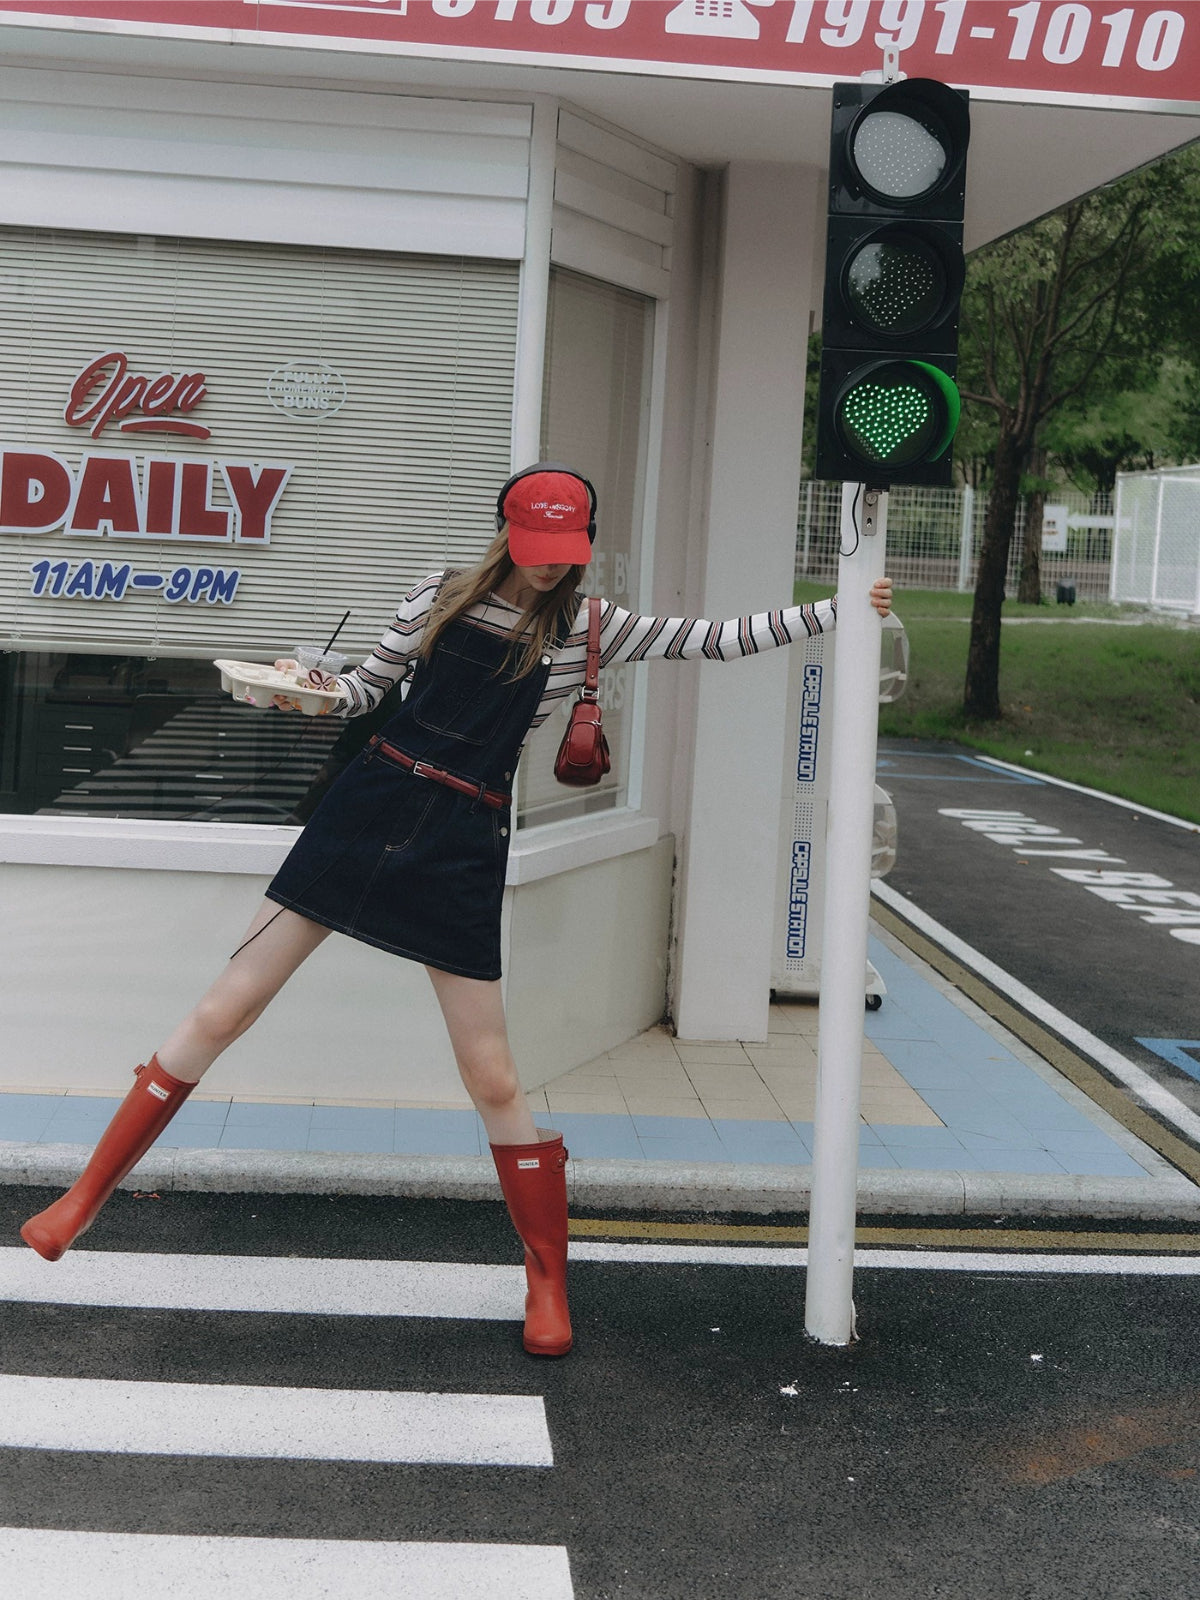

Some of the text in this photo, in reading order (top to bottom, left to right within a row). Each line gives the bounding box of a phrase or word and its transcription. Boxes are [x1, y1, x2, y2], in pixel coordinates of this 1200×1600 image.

[785, 0, 1186, 72] 1991-1010
[64, 351, 209, 440] Open
[283, 395, 331, 409] BUNS
[0, 450, 294, 543] DAILY
